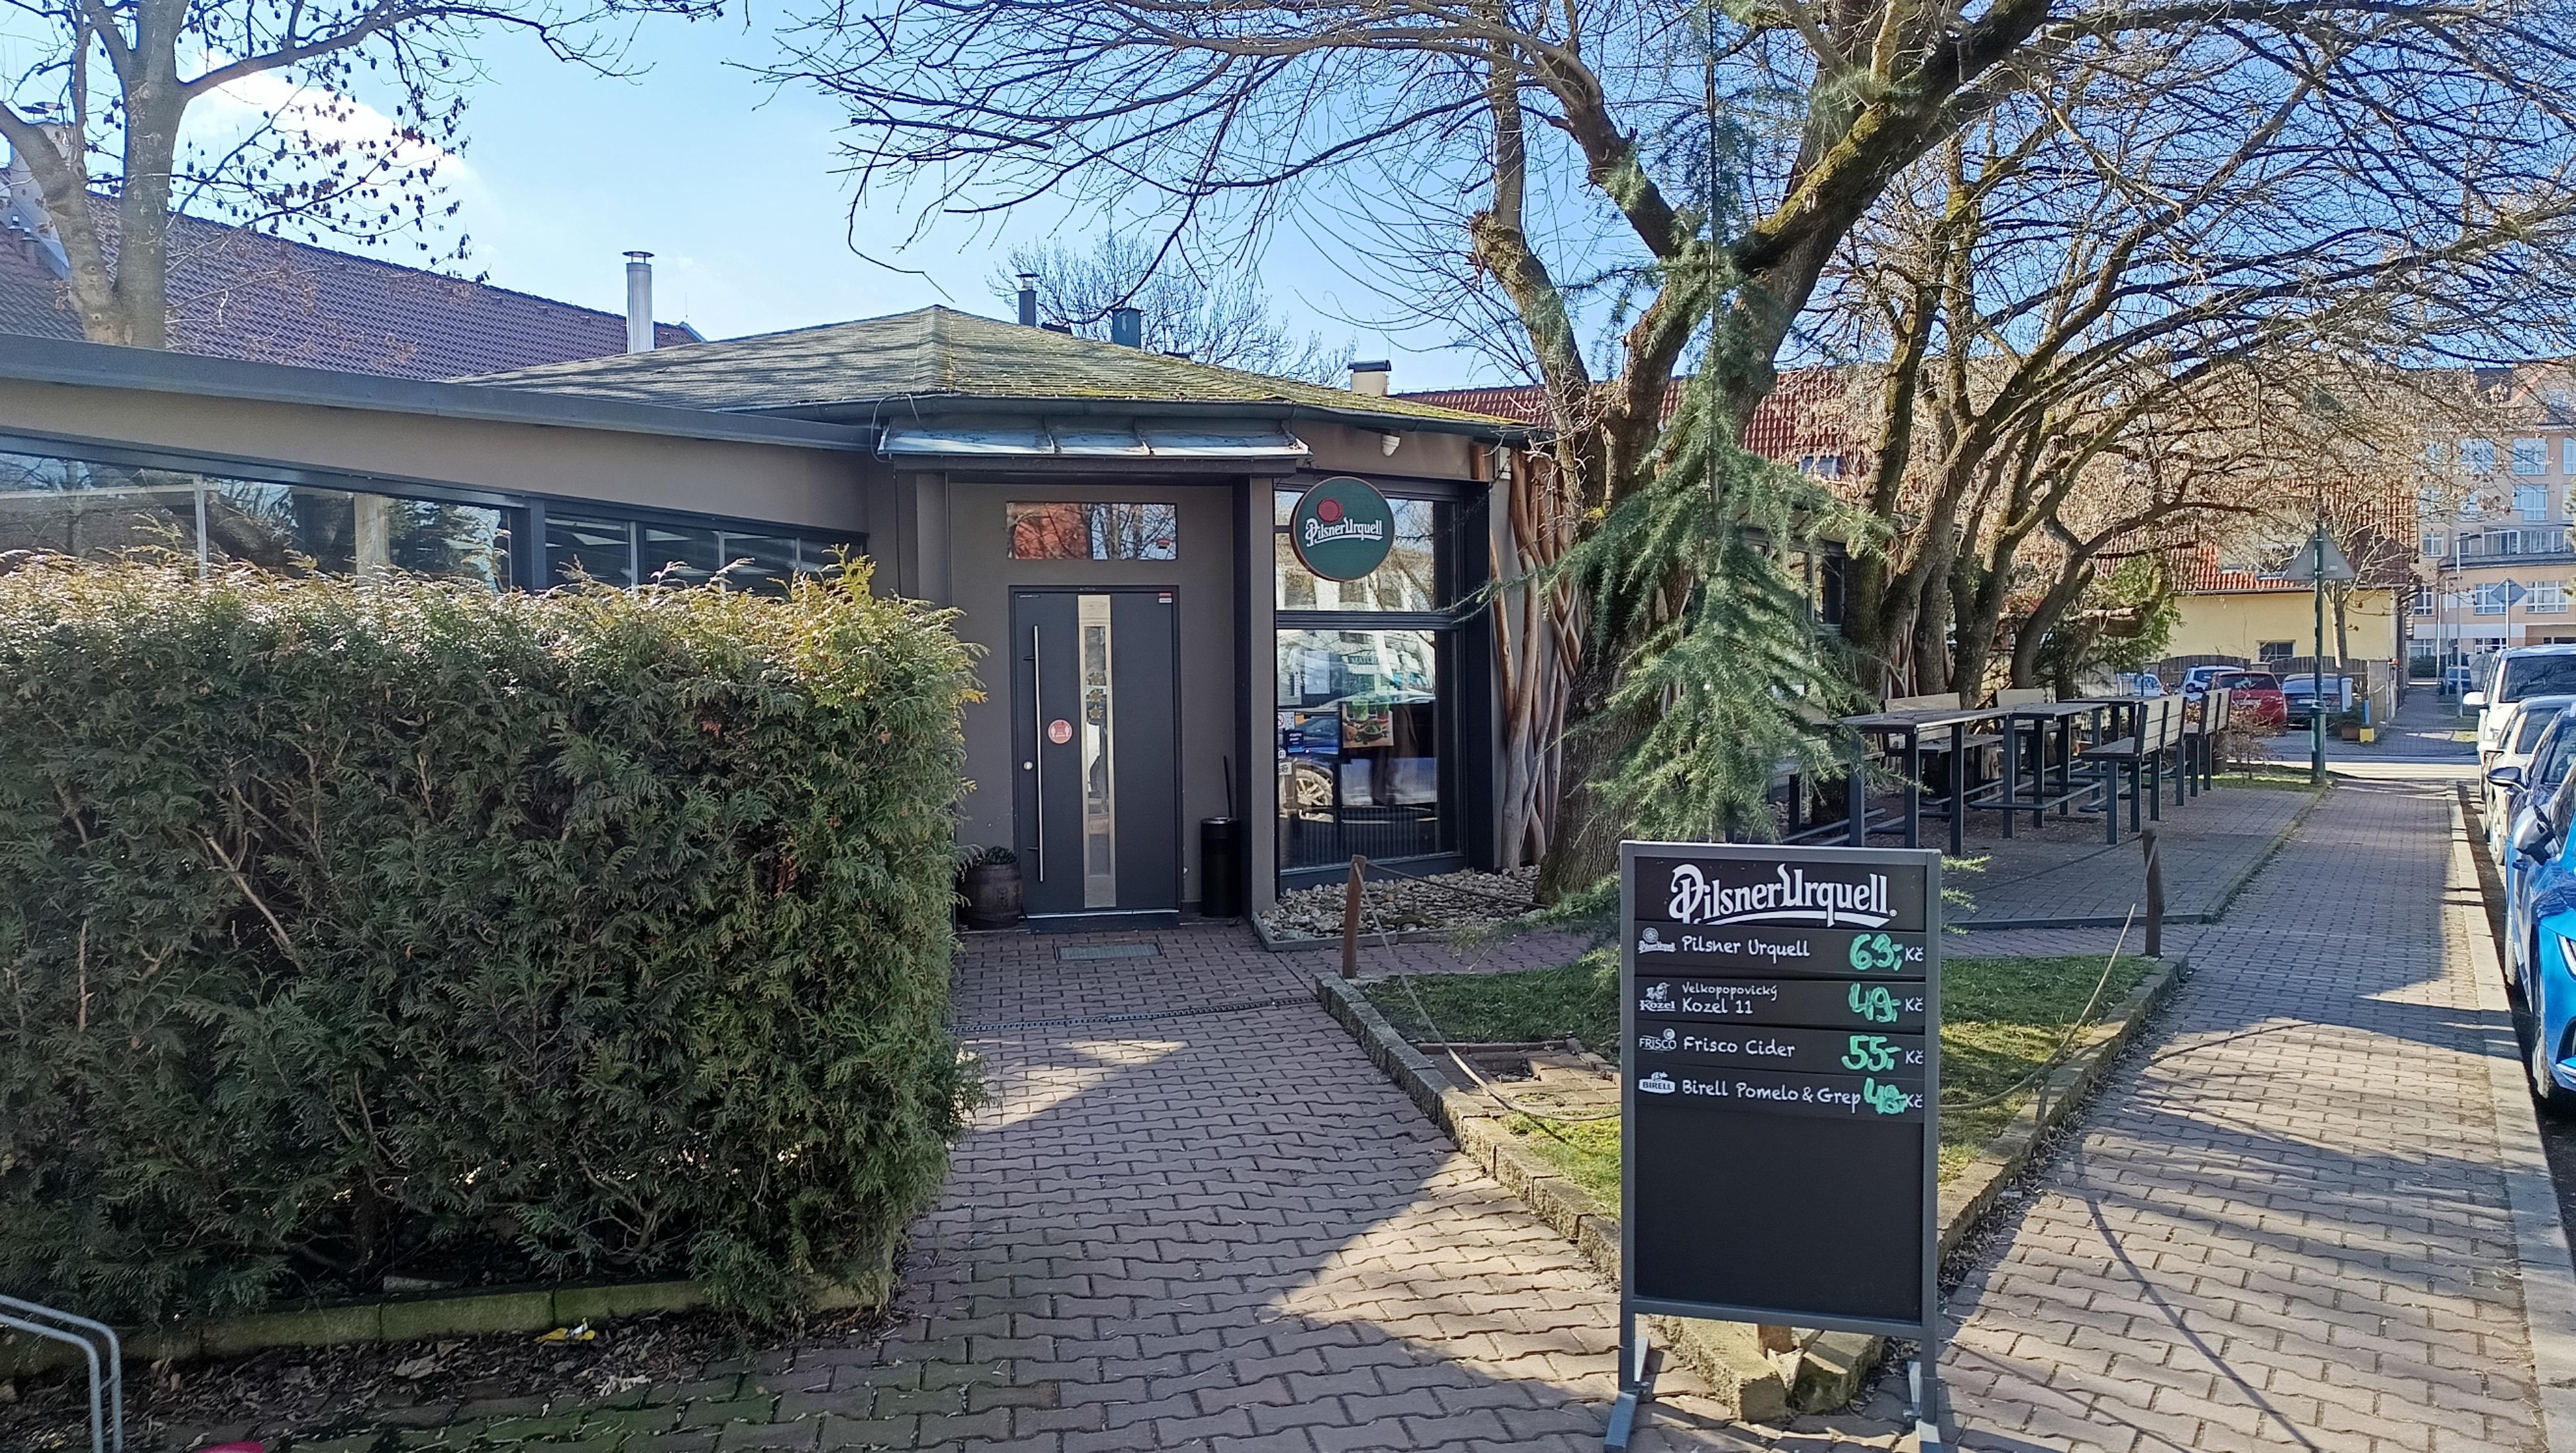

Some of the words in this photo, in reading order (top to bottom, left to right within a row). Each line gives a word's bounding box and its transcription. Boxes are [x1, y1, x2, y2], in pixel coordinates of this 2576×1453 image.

[1681, 935, 1741, 954] Pilsner
[1748, 938, 1811, 964] Urquell
[1904, 946, 1924, 962] Kč
[1681, 981, 1777, 1002] Velkopopovický
[1639, 1000, 1676, 1012] Kozel
[1682, 996, 1728, 1014] Kozel
[1735, 1000, 1754, 1014] 11
[1904, 996, 1924, 1012] Kč
[1639, 1037, 1677, 1050] FRISCO
[1683, 1036, 1738, 1053] Frisco
[1745, 1038, 1795, 1058] Cider
[1904, 1049, 1924, 1065] Kč
[1642, 1081, 1672, 1091] BIRELL
[1682, 1079, 1729, 1096] Birell
[1736, 1082, 1799, 1101] Pomelo
[1802, 1087, 1814, 1103] &
[1816, 1087, 1861, 1114] Grep
[1904, 1093, 1924, 1108] Kč
